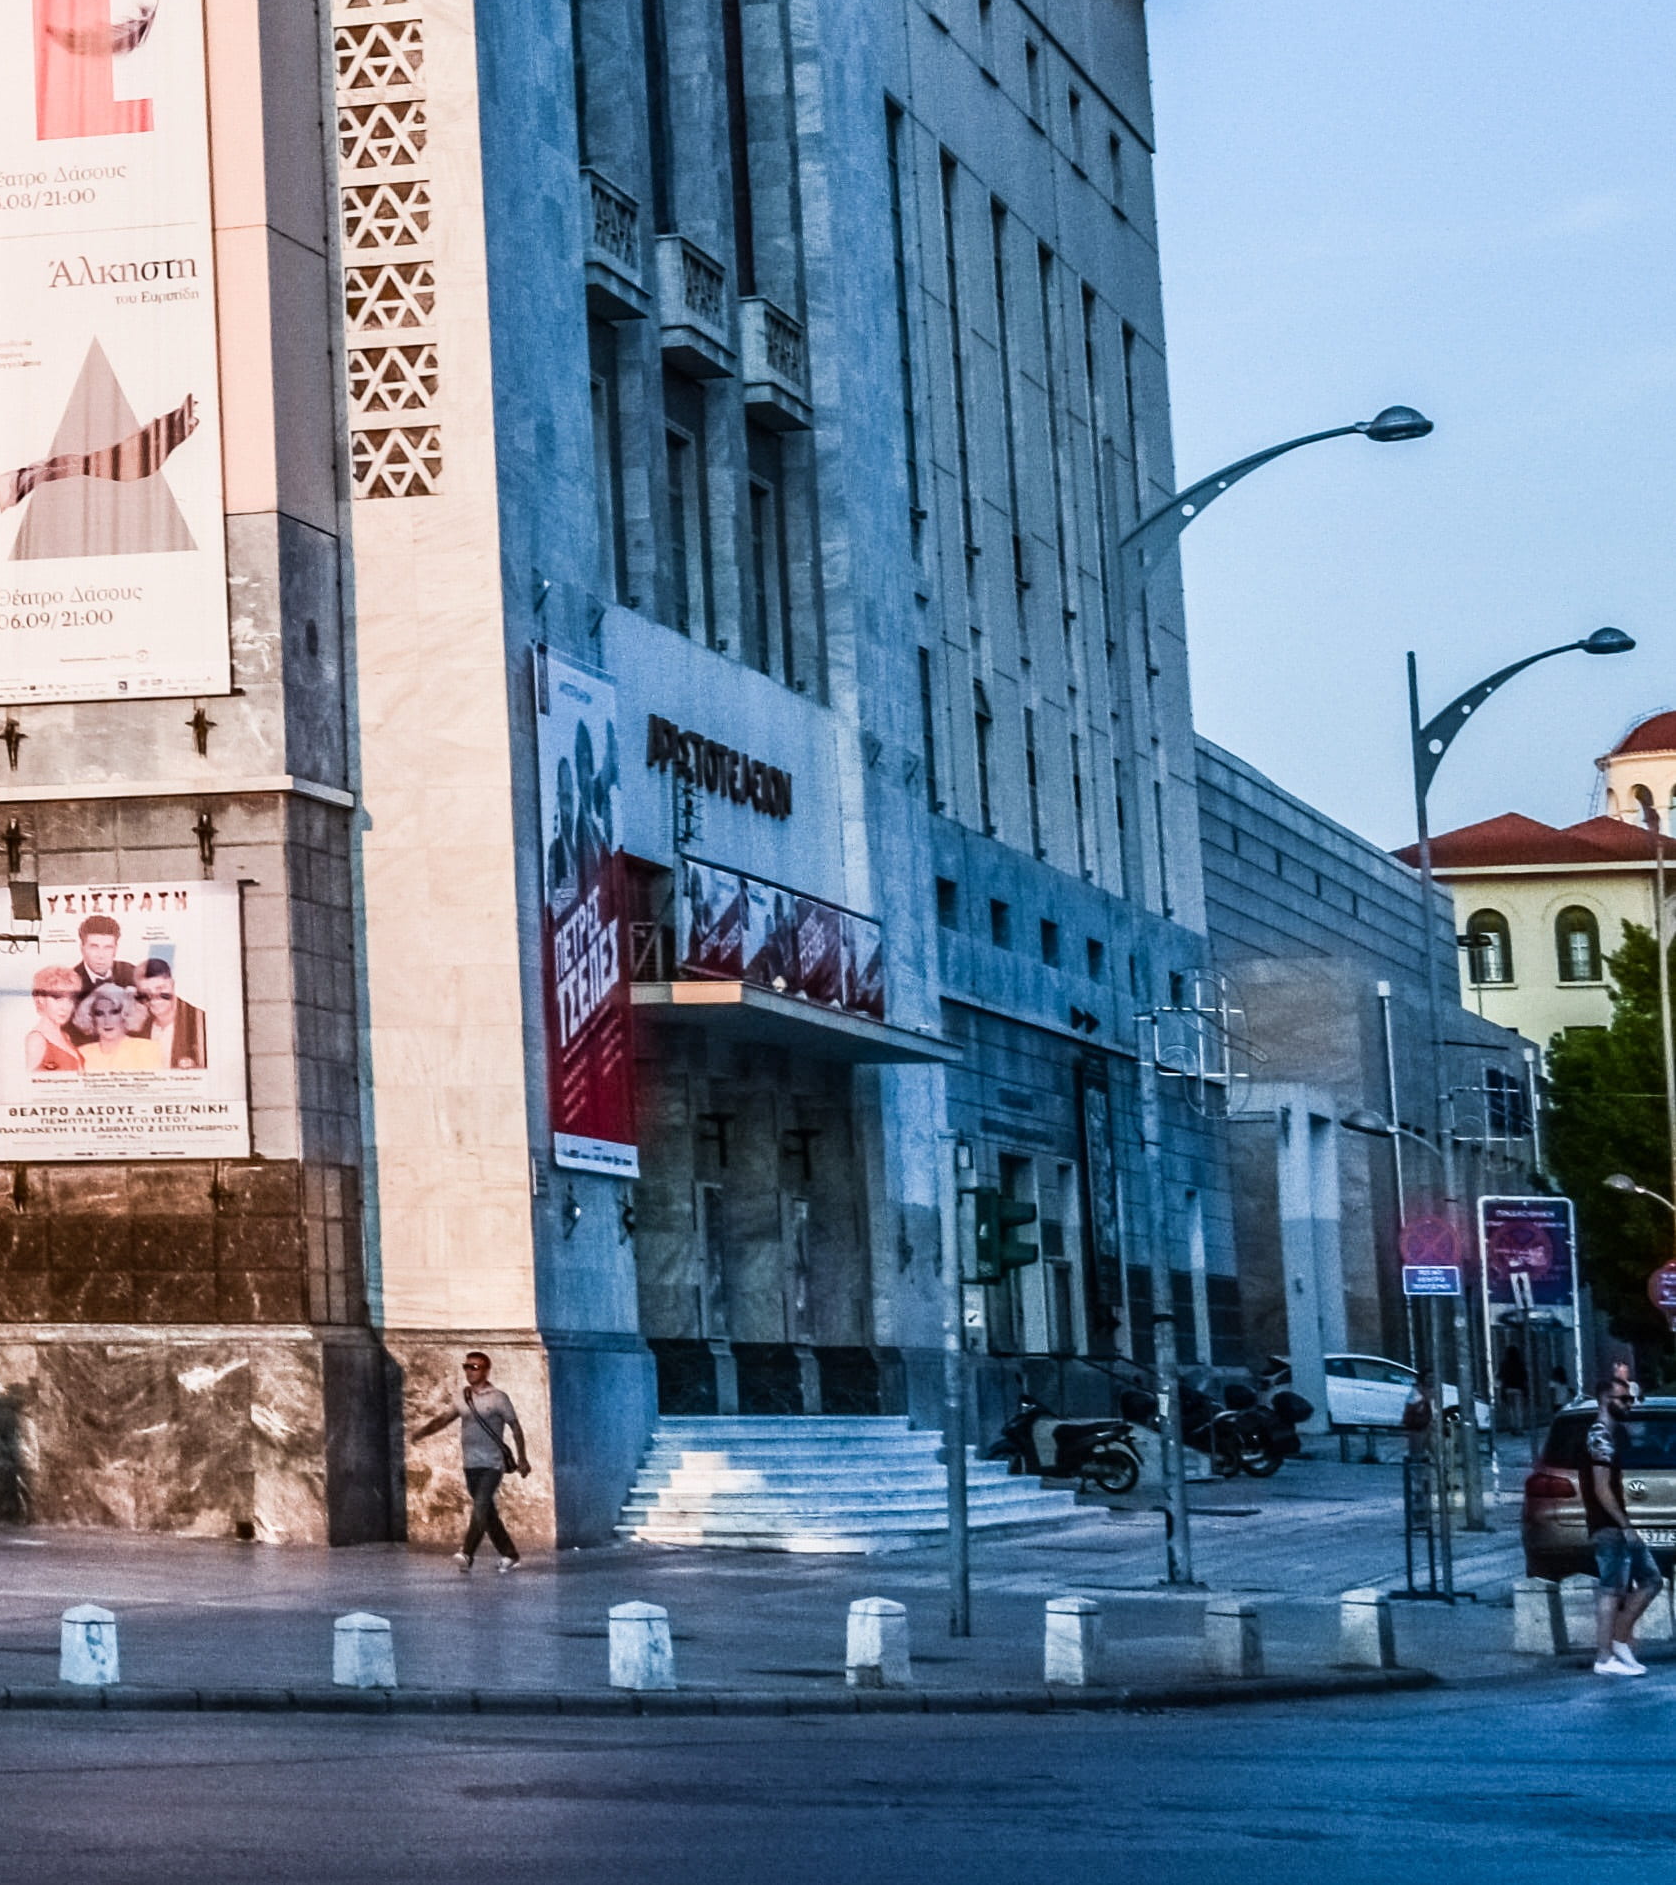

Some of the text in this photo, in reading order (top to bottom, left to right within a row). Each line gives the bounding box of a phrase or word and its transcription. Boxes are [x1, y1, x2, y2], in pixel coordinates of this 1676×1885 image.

[53, 164, 127, 183] Δάσους
[48, 255, 198, 288] Άλκηστη
[69, 585, 144, 604] Δάσους
[46, 891, 189, 916] ΥΣΙΣΤΡΑΤΗ
[8, 1106, 69, 1117] ΘΕΑΤΡΟ
[75, 1105, 135, 1116] ΔΑΣΟΥΣ
